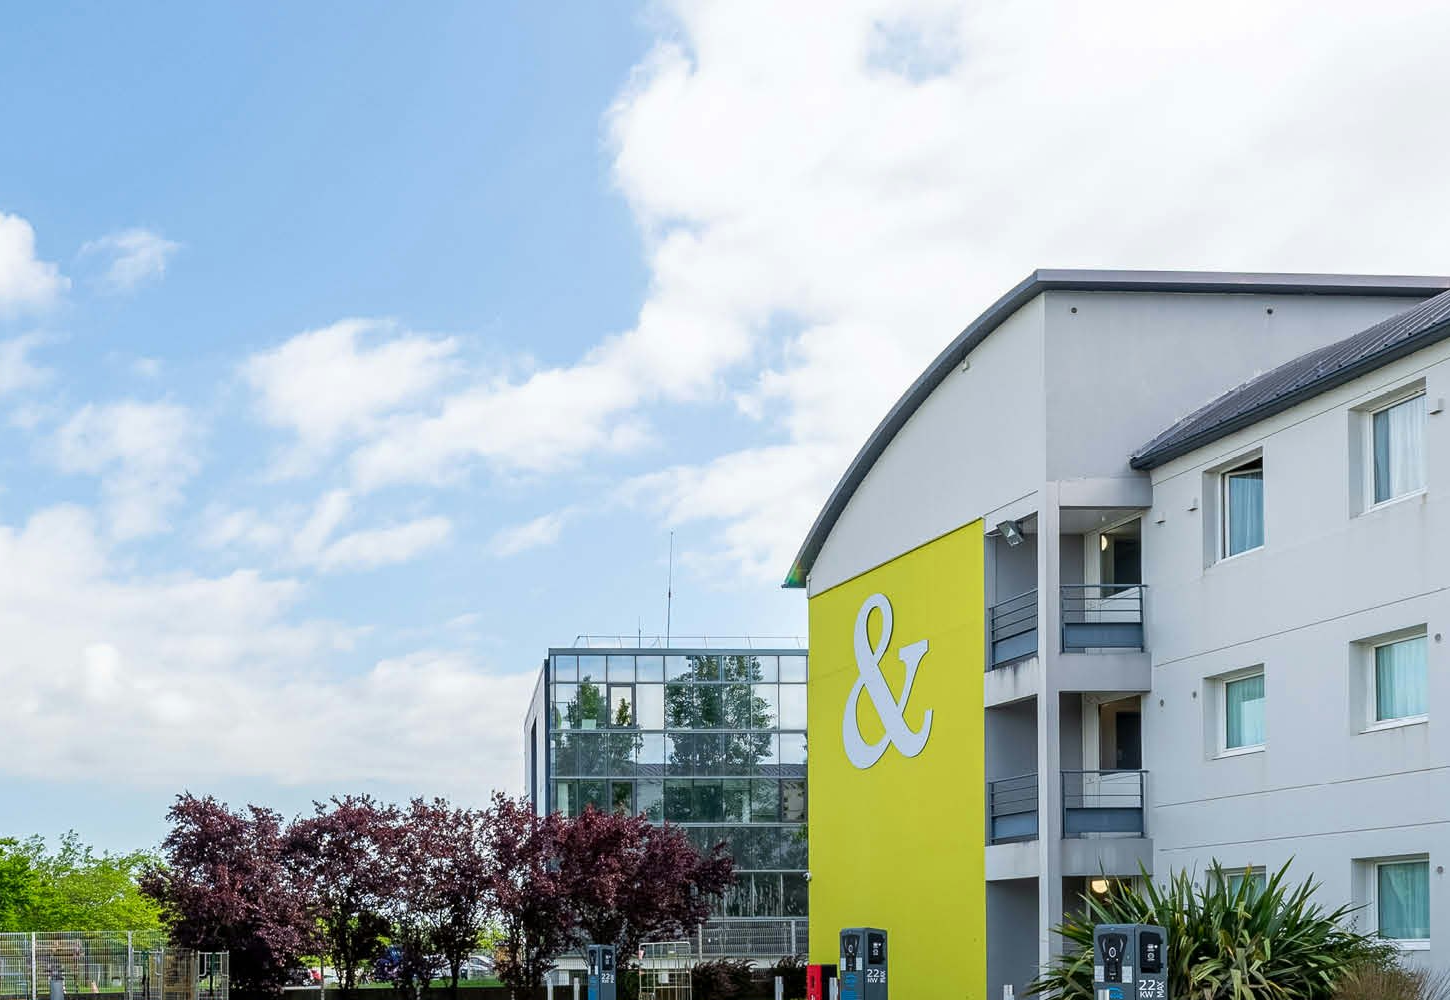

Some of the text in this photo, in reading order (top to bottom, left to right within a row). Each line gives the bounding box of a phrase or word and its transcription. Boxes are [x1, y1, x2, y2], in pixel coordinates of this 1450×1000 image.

[842, 593, 934, 770] &
[866, 968, 880, 978] 22
[1138, 979, 1156, 991] 22
[1156, 981, 1165, 998] MAX
